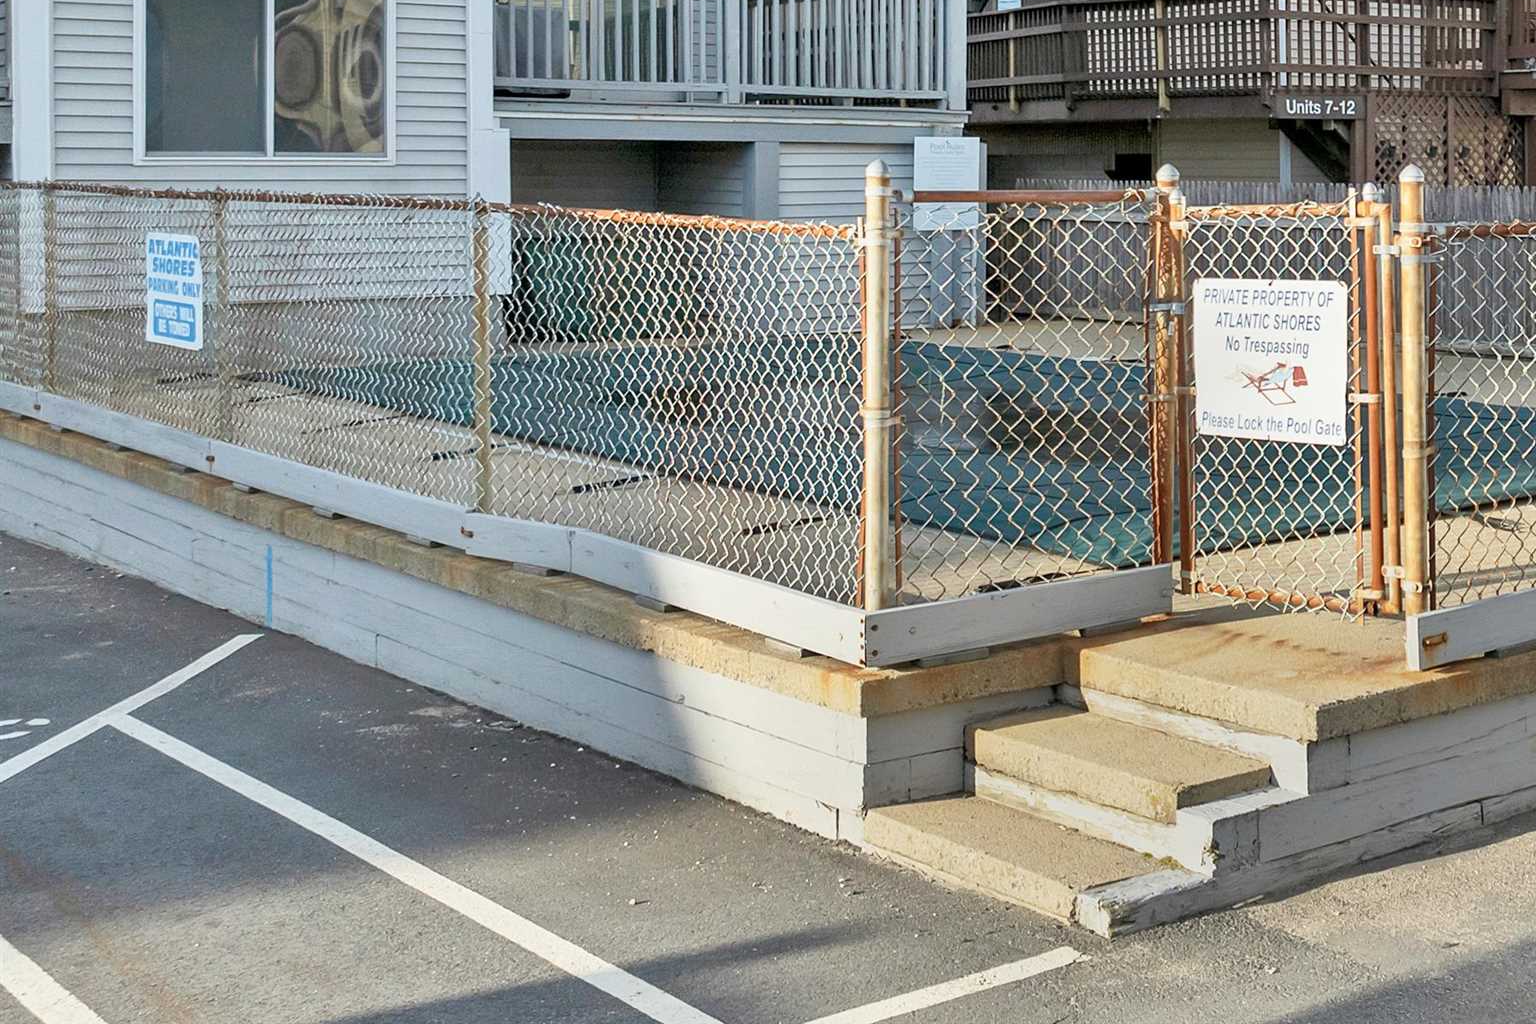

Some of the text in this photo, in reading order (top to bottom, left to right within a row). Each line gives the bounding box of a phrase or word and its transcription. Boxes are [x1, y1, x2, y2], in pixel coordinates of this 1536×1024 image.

[1286, 99, 1356, 114] Units 7-12
[148, 239, 198, 258] ATLANTIC
[152, 257, 195, 277] SHORES
[1203, 288, 1335, 307] PRIVATE PROPERTY OF
[1215, 312, 1321, 331] ATLANTIC SHORES
[1225, 336, 1310, 358] No Trespassing
[1201, 411, 1342, 436] Please Lock the Pool Gate
